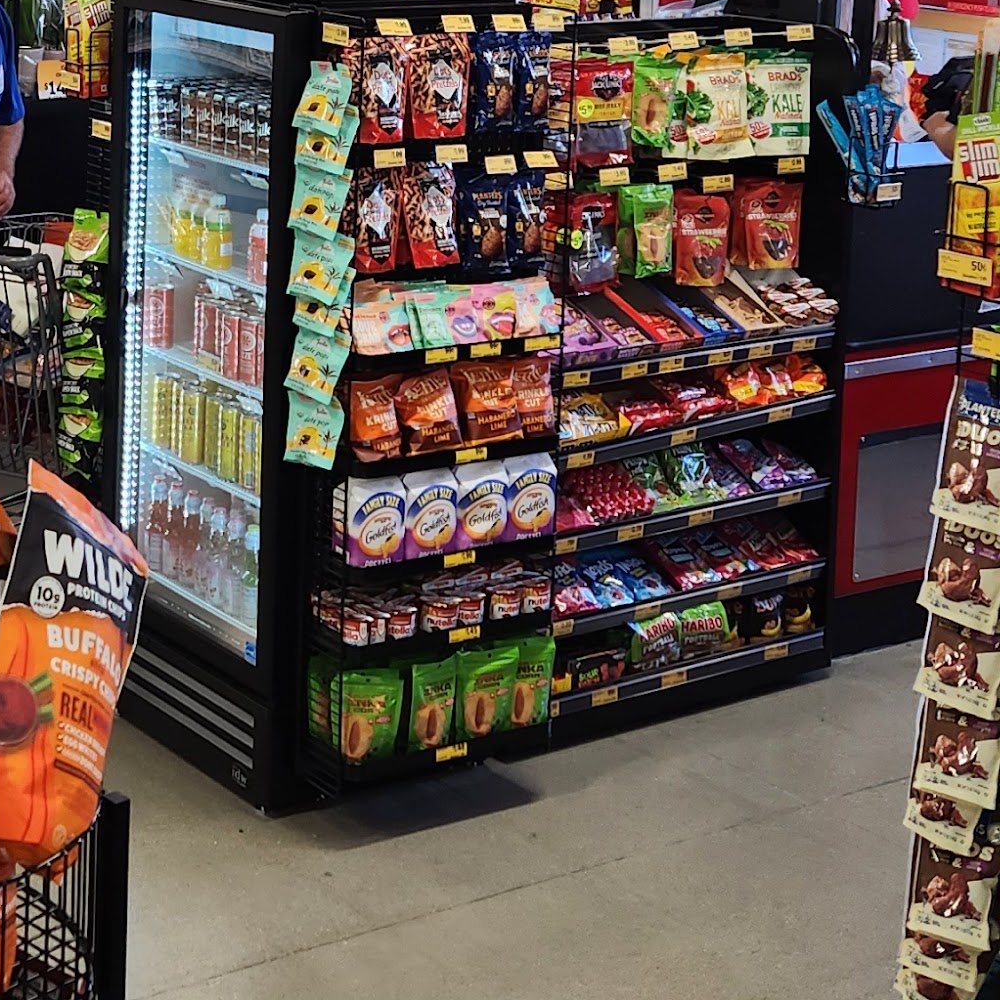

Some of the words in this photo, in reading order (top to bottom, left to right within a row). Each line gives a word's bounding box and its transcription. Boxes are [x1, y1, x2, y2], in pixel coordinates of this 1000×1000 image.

[771, 93, 804, 113] KALE
[524, 398, 541, 407] CUT
[959, 399, 1000, 421] PLANTE
[366, 412, 397, 426] KRINK
[477, 409, 516, 424] HABANERO
[490, 421, 507, 431] LIME
[522, 414, 551, 426] ABANERO
[527, 423, 544, 433] LIME
[956, 420, 1000, 446] DUO
[373, 438, 402, 452] HABANE
[434, 433, 450, 443] LIME
[515, 473, 538, 490] FAMILY
[538, 471, 552, 485] SIZE
[417, 488, 438, 507] FAMILY
[439, 488, 454, 502] SIZE
[469, 483, 490, 501] FAMILY
[491, 481, 505, 496] SIZE
[362, 496, 385, 516] FAMILY
[386, 494, 400, 508] SIZE
[43, 528, 133, 613] WILDE
[36, 585, 60, 603] 10g
[66, 582, 109, 612] PROTEIN
[528, 597, 550, 607] nutel
[498, 604, 520, 613] nutel
[681, 615, 723, 634] HARIBO
[46, 623, 122, 688] BUFFALO
[50, 656, 102, 691] CRISPY
[517, 664, 544, 674] NKA
[60, 691, 93, 731] REAL
